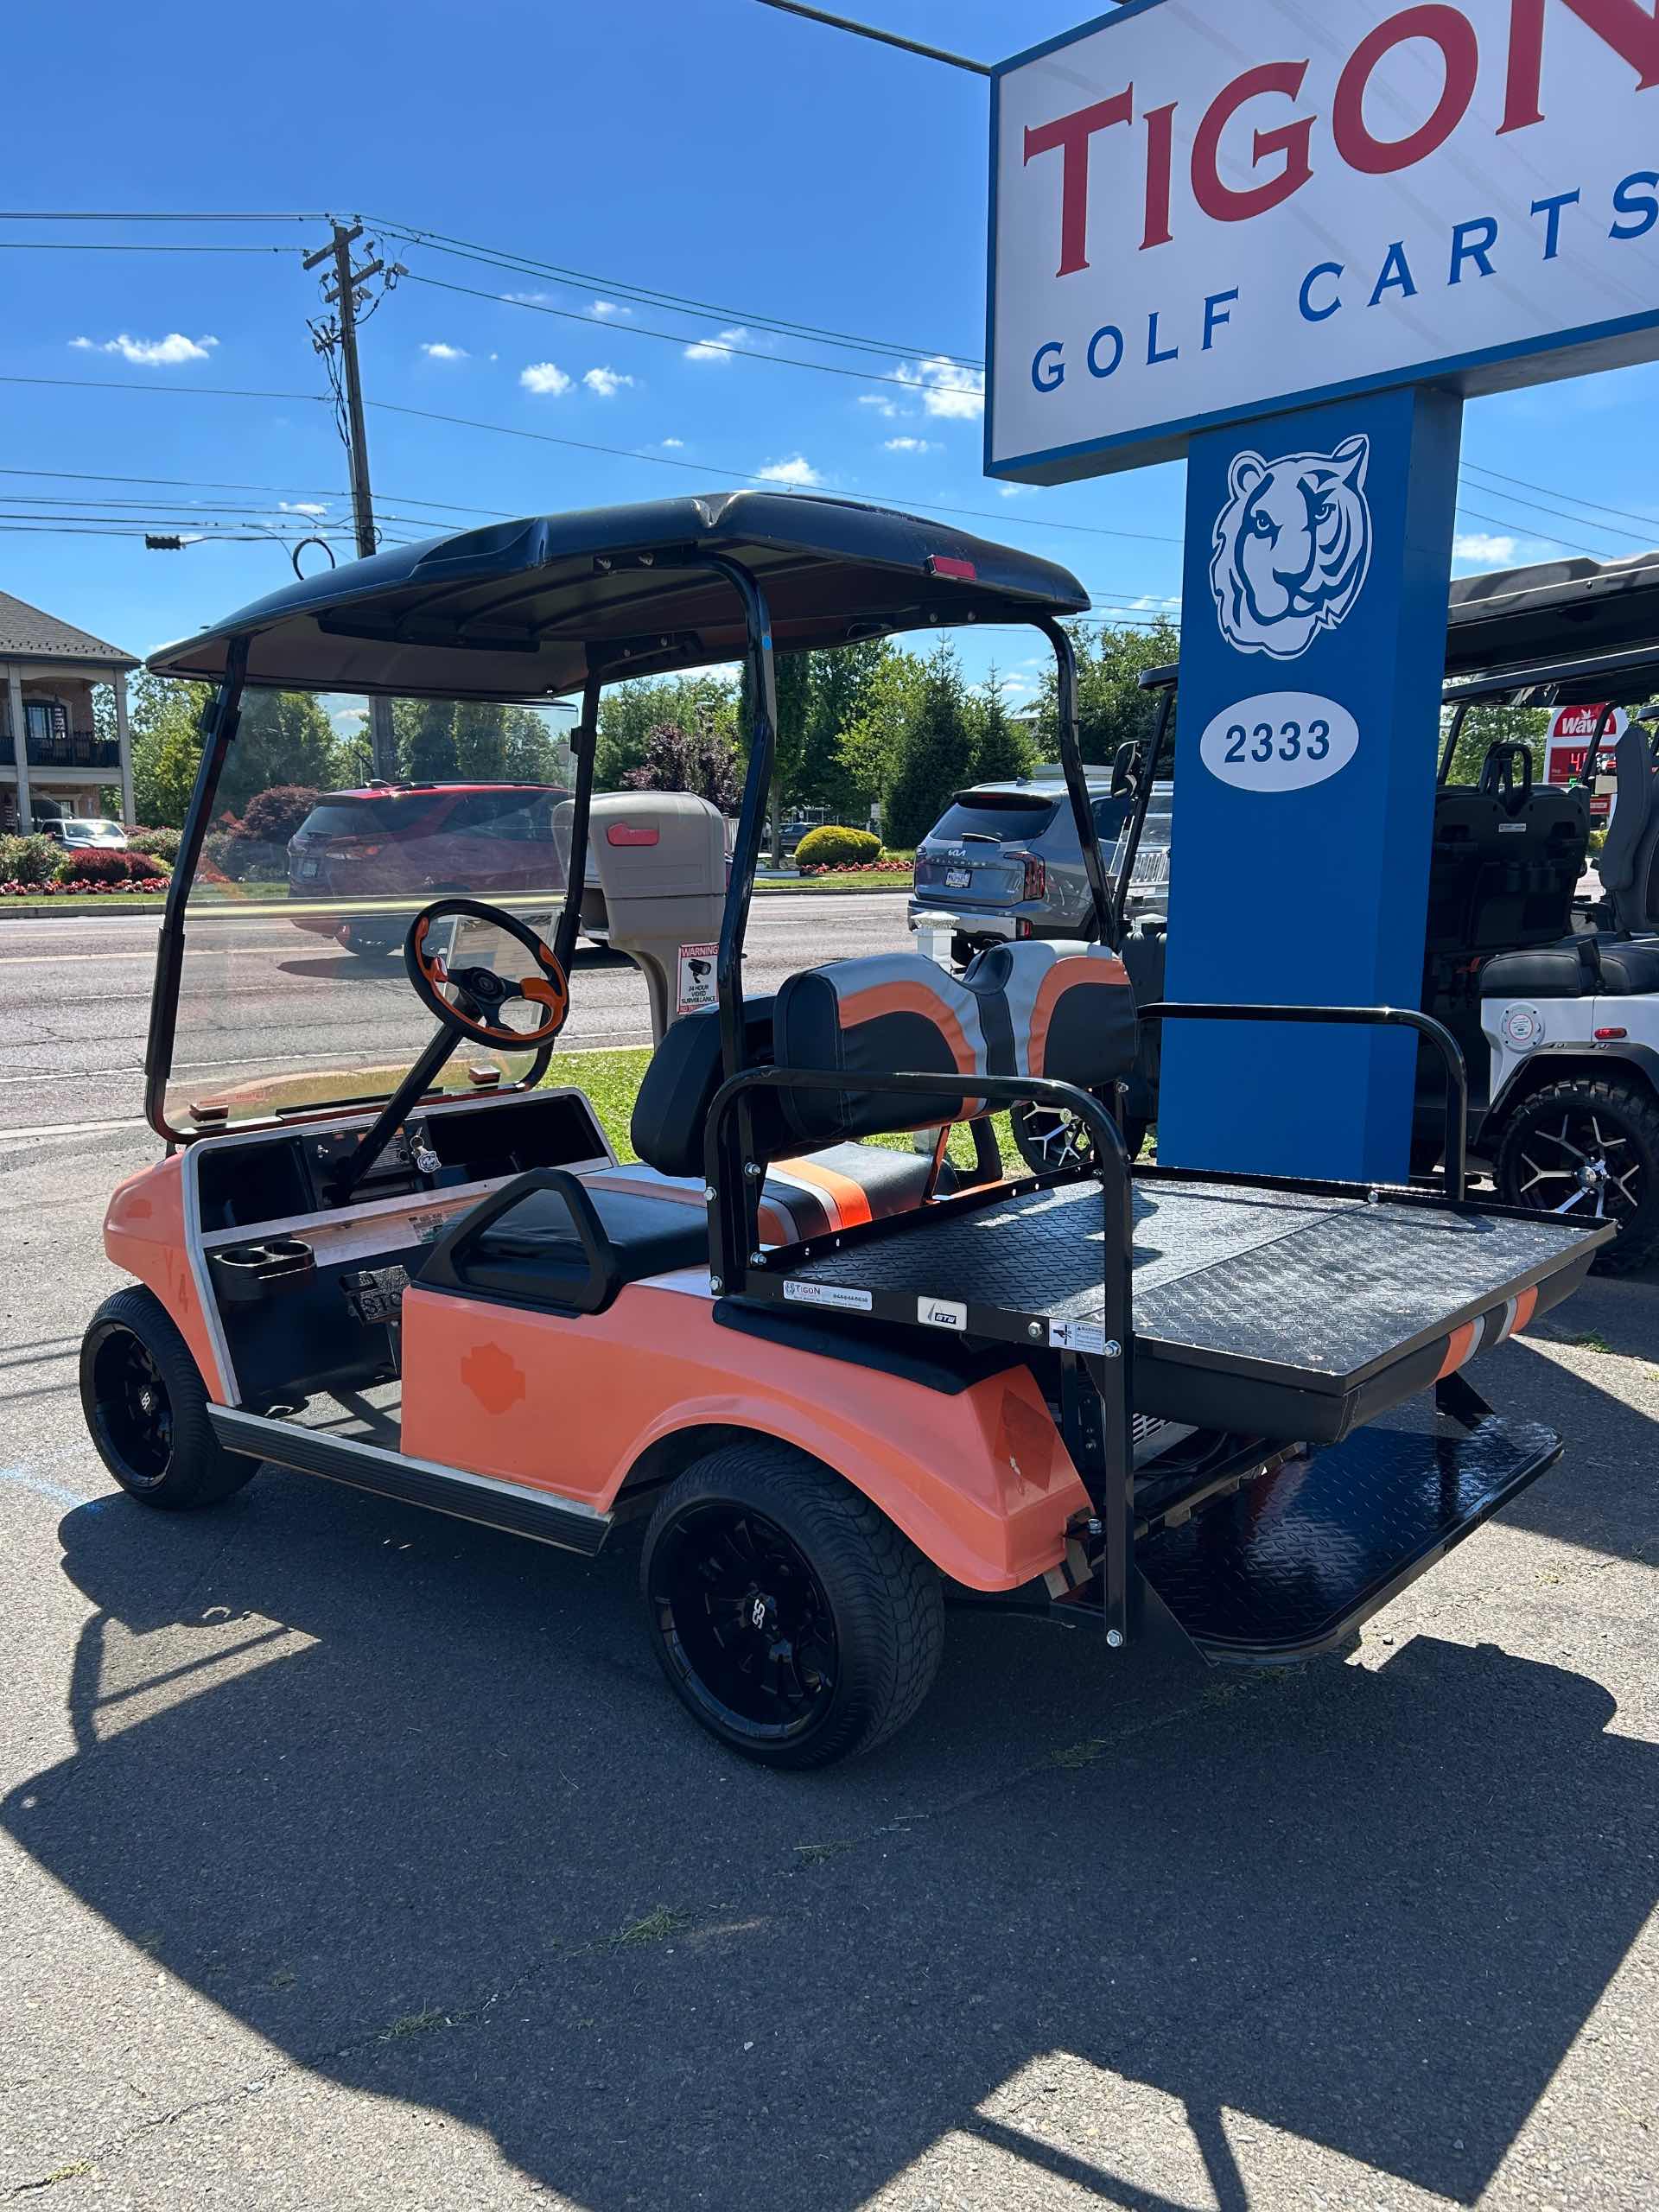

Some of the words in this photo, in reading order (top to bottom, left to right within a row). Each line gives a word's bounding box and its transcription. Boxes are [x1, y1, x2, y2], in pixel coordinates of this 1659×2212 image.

[1023, 0, 1659, 278] TIGON
[1031, 286, 1239, 393] GOLF
[1298, 171, 1659, 322] CARTS
[1224, 719, 1331, 764] 2333
[682, 945, 719, 957] WARNING
[362, 1293, 403, 1314] STO
[795, 1284, 821, 1294] TIGON
